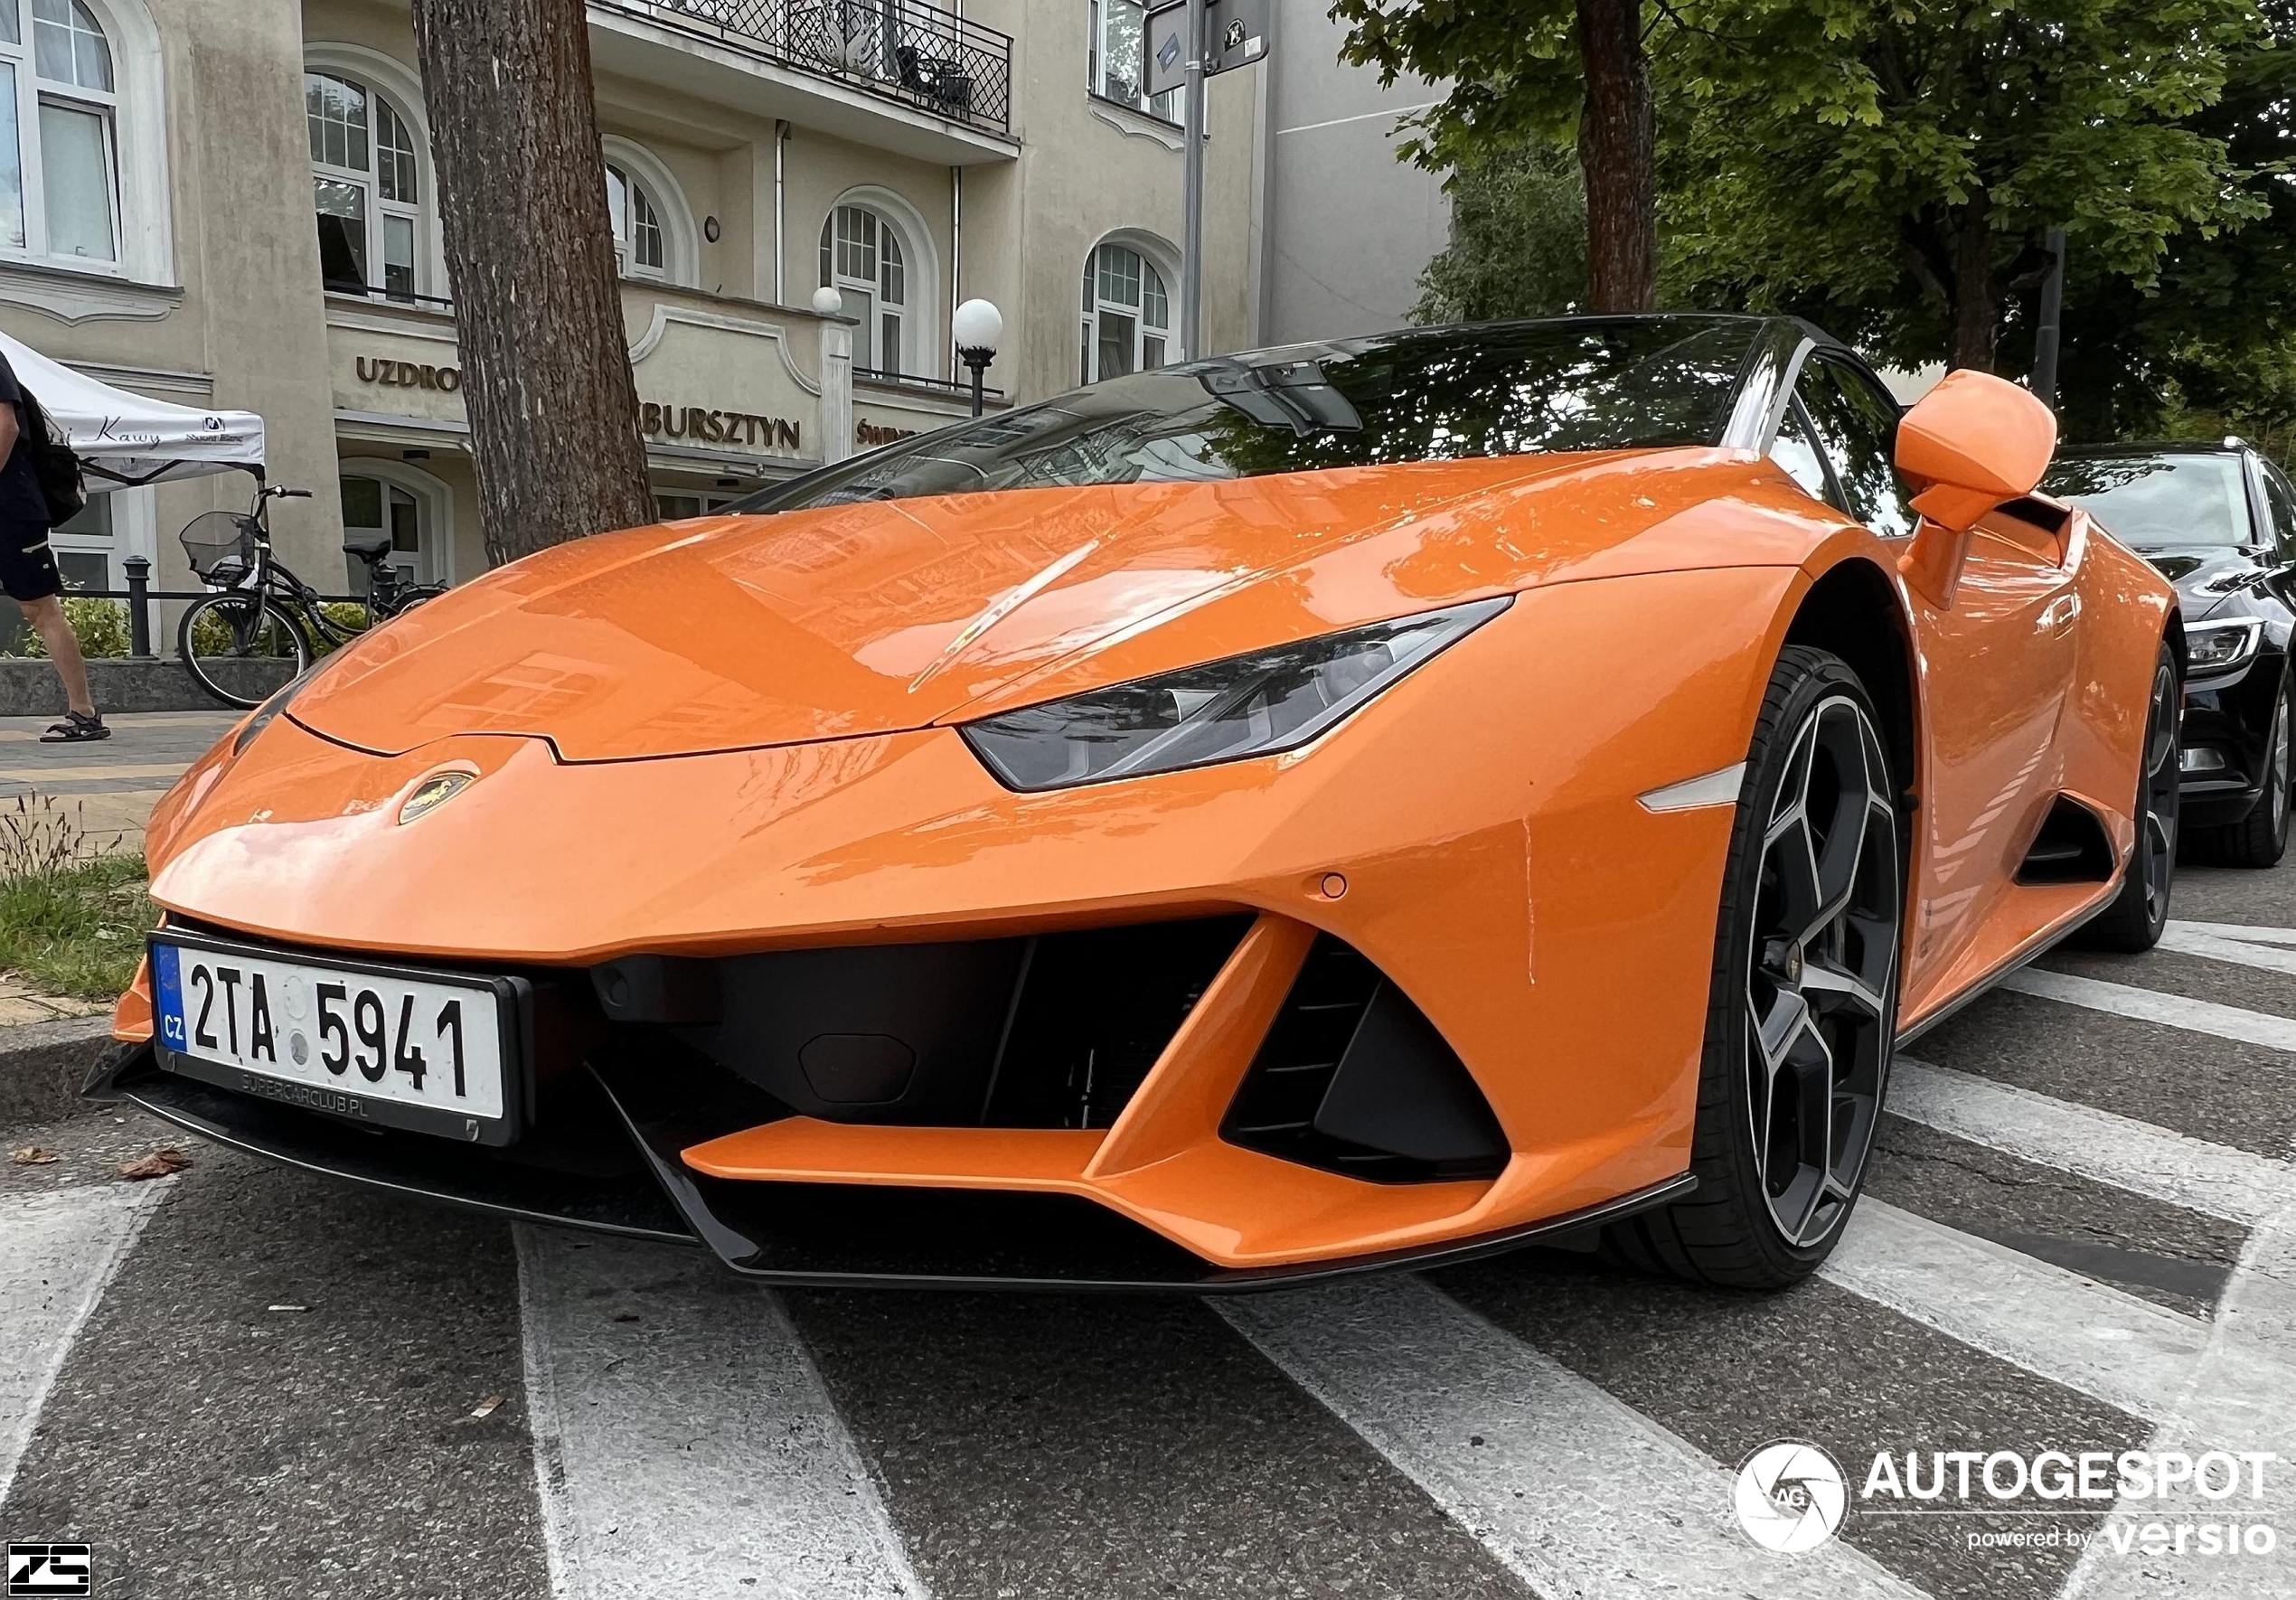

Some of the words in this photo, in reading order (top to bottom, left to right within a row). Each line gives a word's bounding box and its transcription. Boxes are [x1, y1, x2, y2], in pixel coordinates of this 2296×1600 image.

[356, 356, 462, 392] UZDRO
[94, 416, 161, 450] Kawy
[643, 402, 799, 450] BURSZTYN
[165, 1014, 184, 1040] CZ
[191, 964, 277, 1062] 2TA
[316, 983, 466, 1097] 5941
[242, 1074, 369, 1117] SUPERCARCLUB.PL
